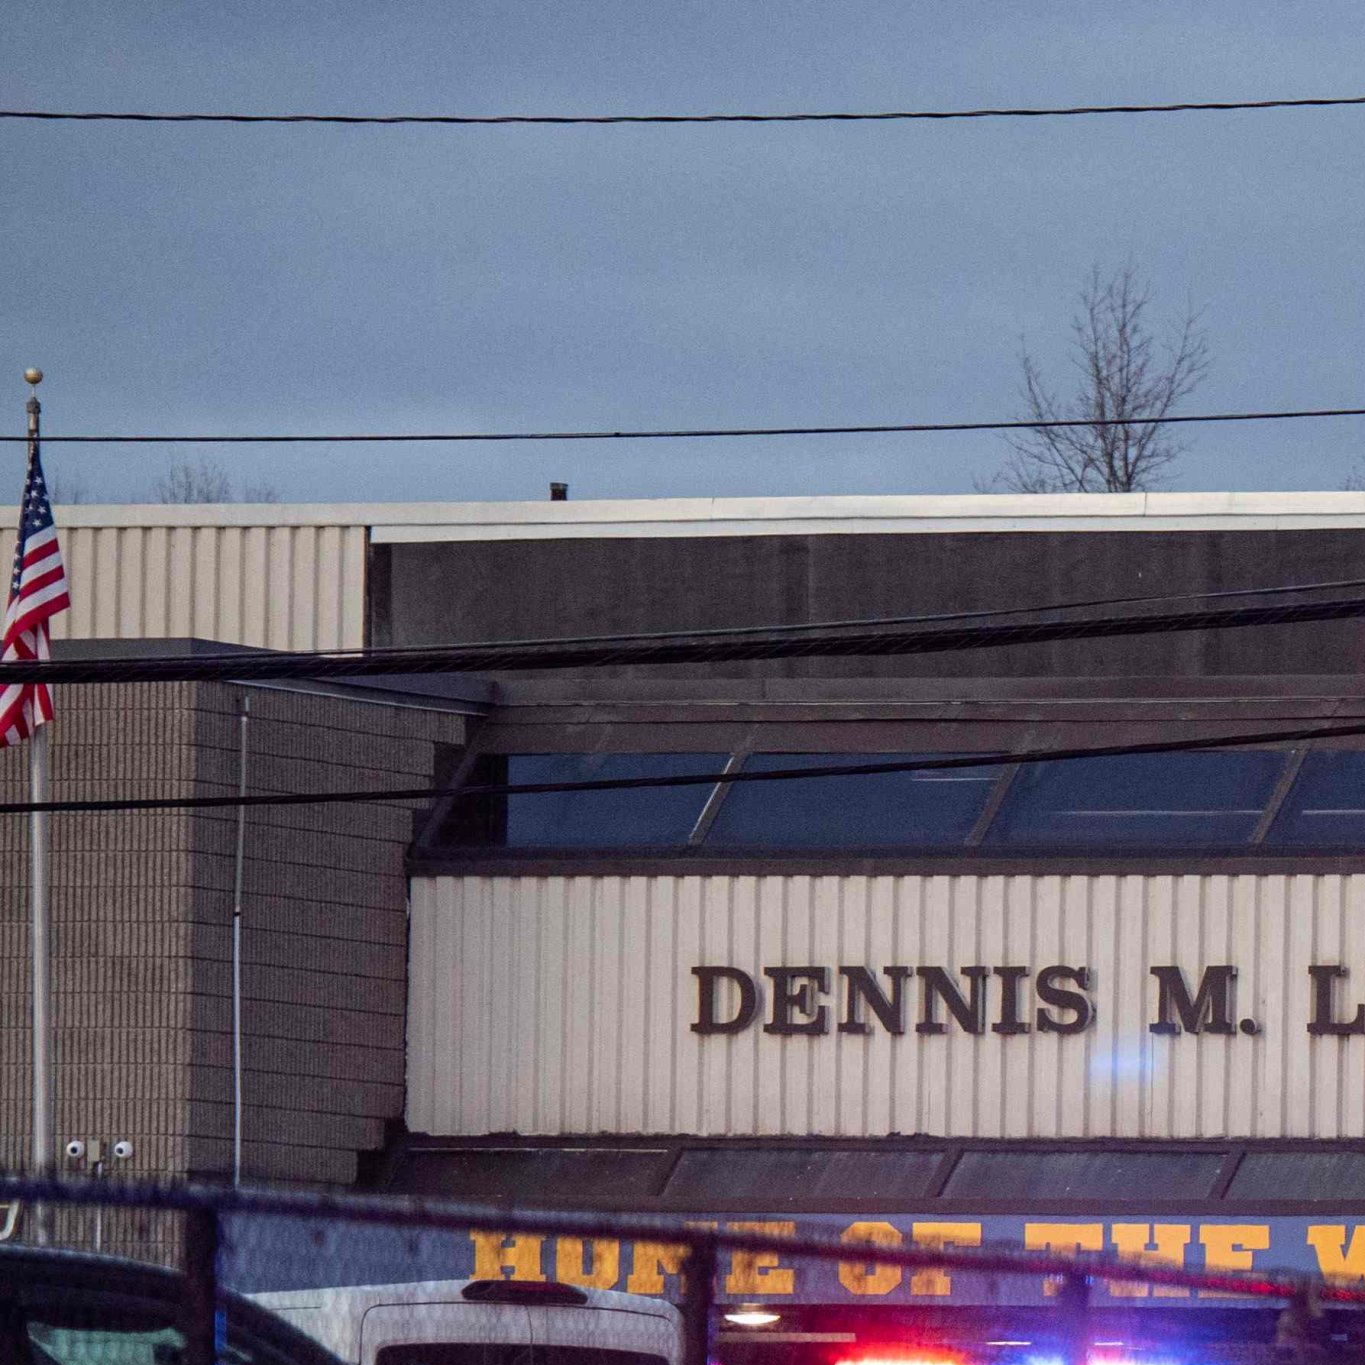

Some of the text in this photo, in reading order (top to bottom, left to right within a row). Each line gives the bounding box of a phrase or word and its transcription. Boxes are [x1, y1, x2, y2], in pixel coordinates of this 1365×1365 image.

[690, 965, 1097, 1037] DENNIS
[1149, 965, 1262, 1036] M.
[838, 1221, 982, 1296] OF
